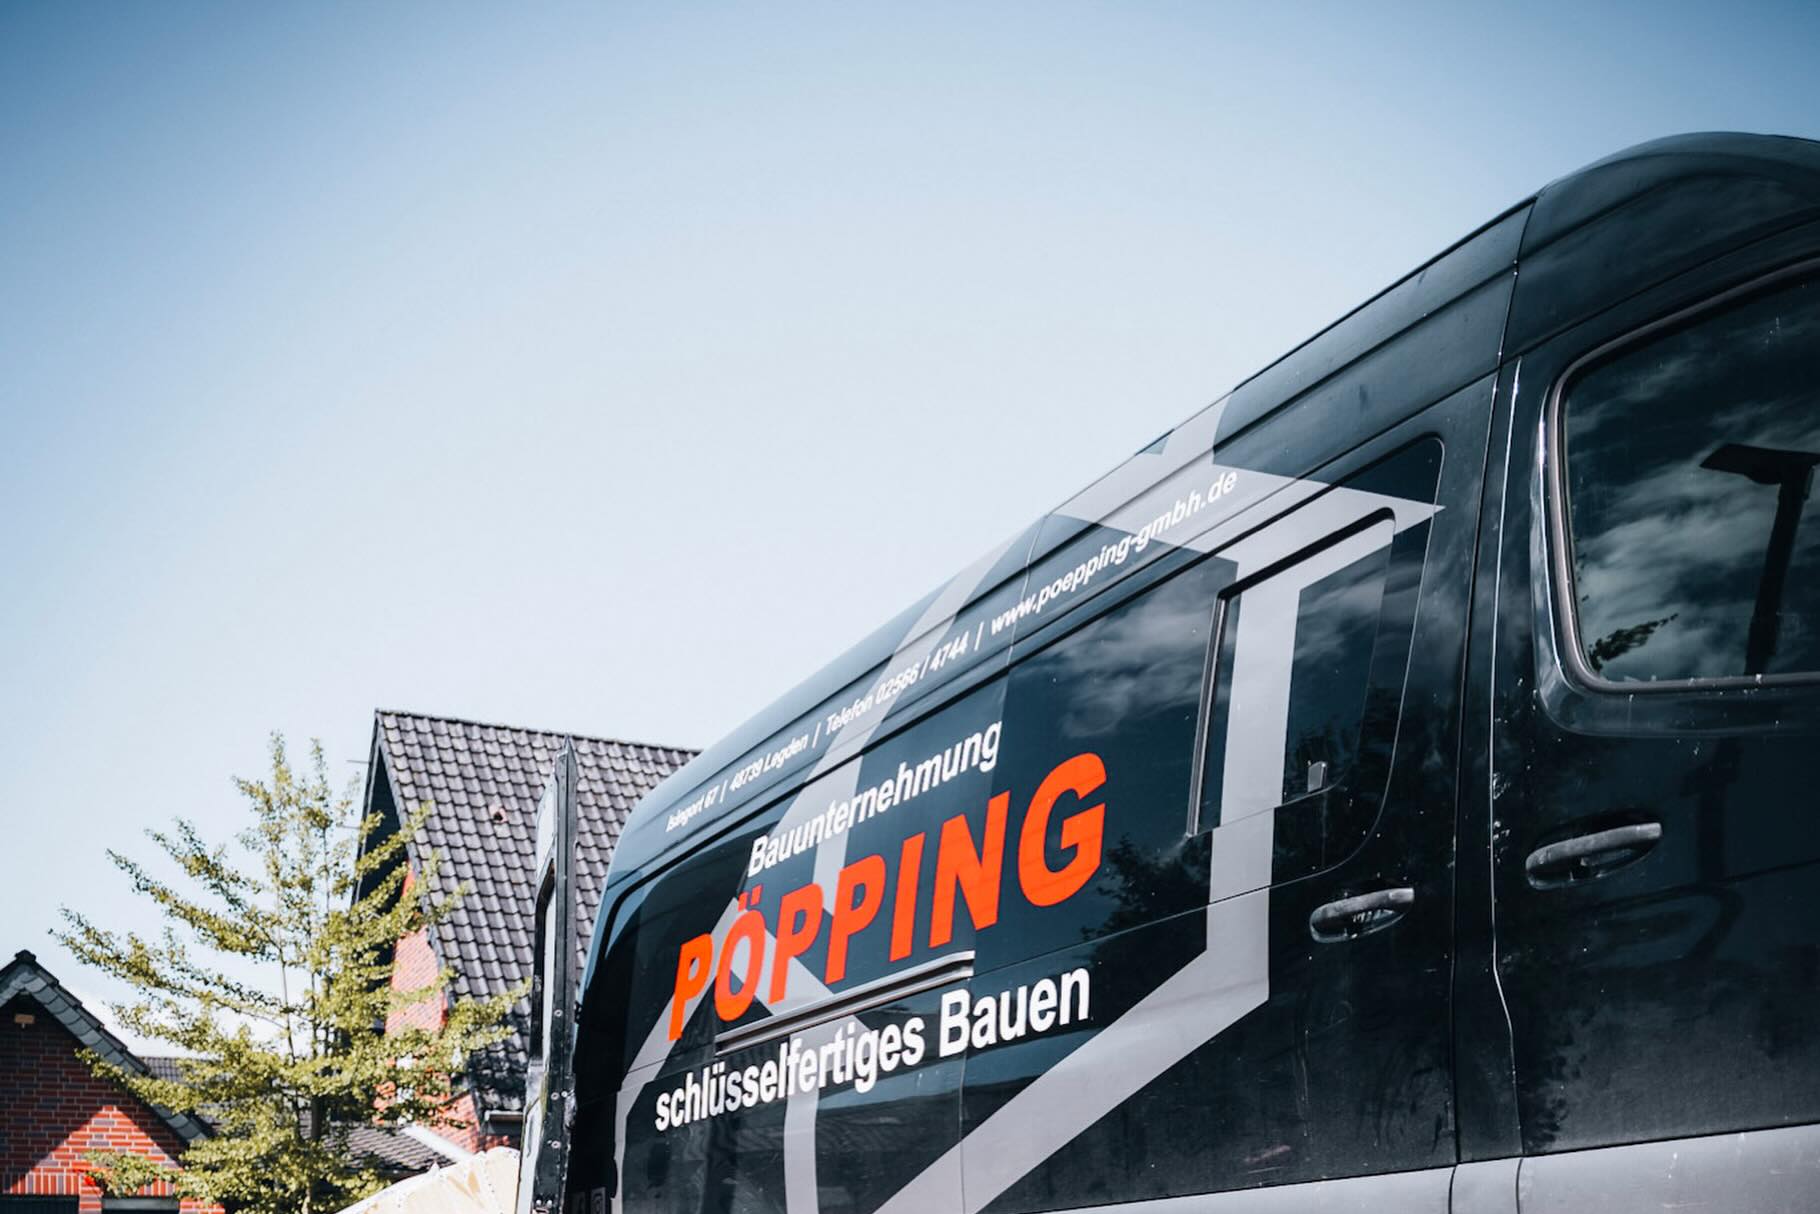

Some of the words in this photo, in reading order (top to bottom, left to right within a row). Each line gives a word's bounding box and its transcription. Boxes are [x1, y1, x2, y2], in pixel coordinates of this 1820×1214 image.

[763, 734, 809, 772] Legden
[825, 693, 874, 736] Telefon
[874, 662, 921, 705] 02566
[929, 630, 970, 672] 4744
[990, 471, 1238, 636] www.poepping-gmbh.de
[667, 752, 1107, 1041] PÖPPING
[747, 720, 1003, 878] Bauunternehmung
[654, 1016, 925, 1132] schlüsselfertiges
[938, 967, 1092, 1059] Bauen
